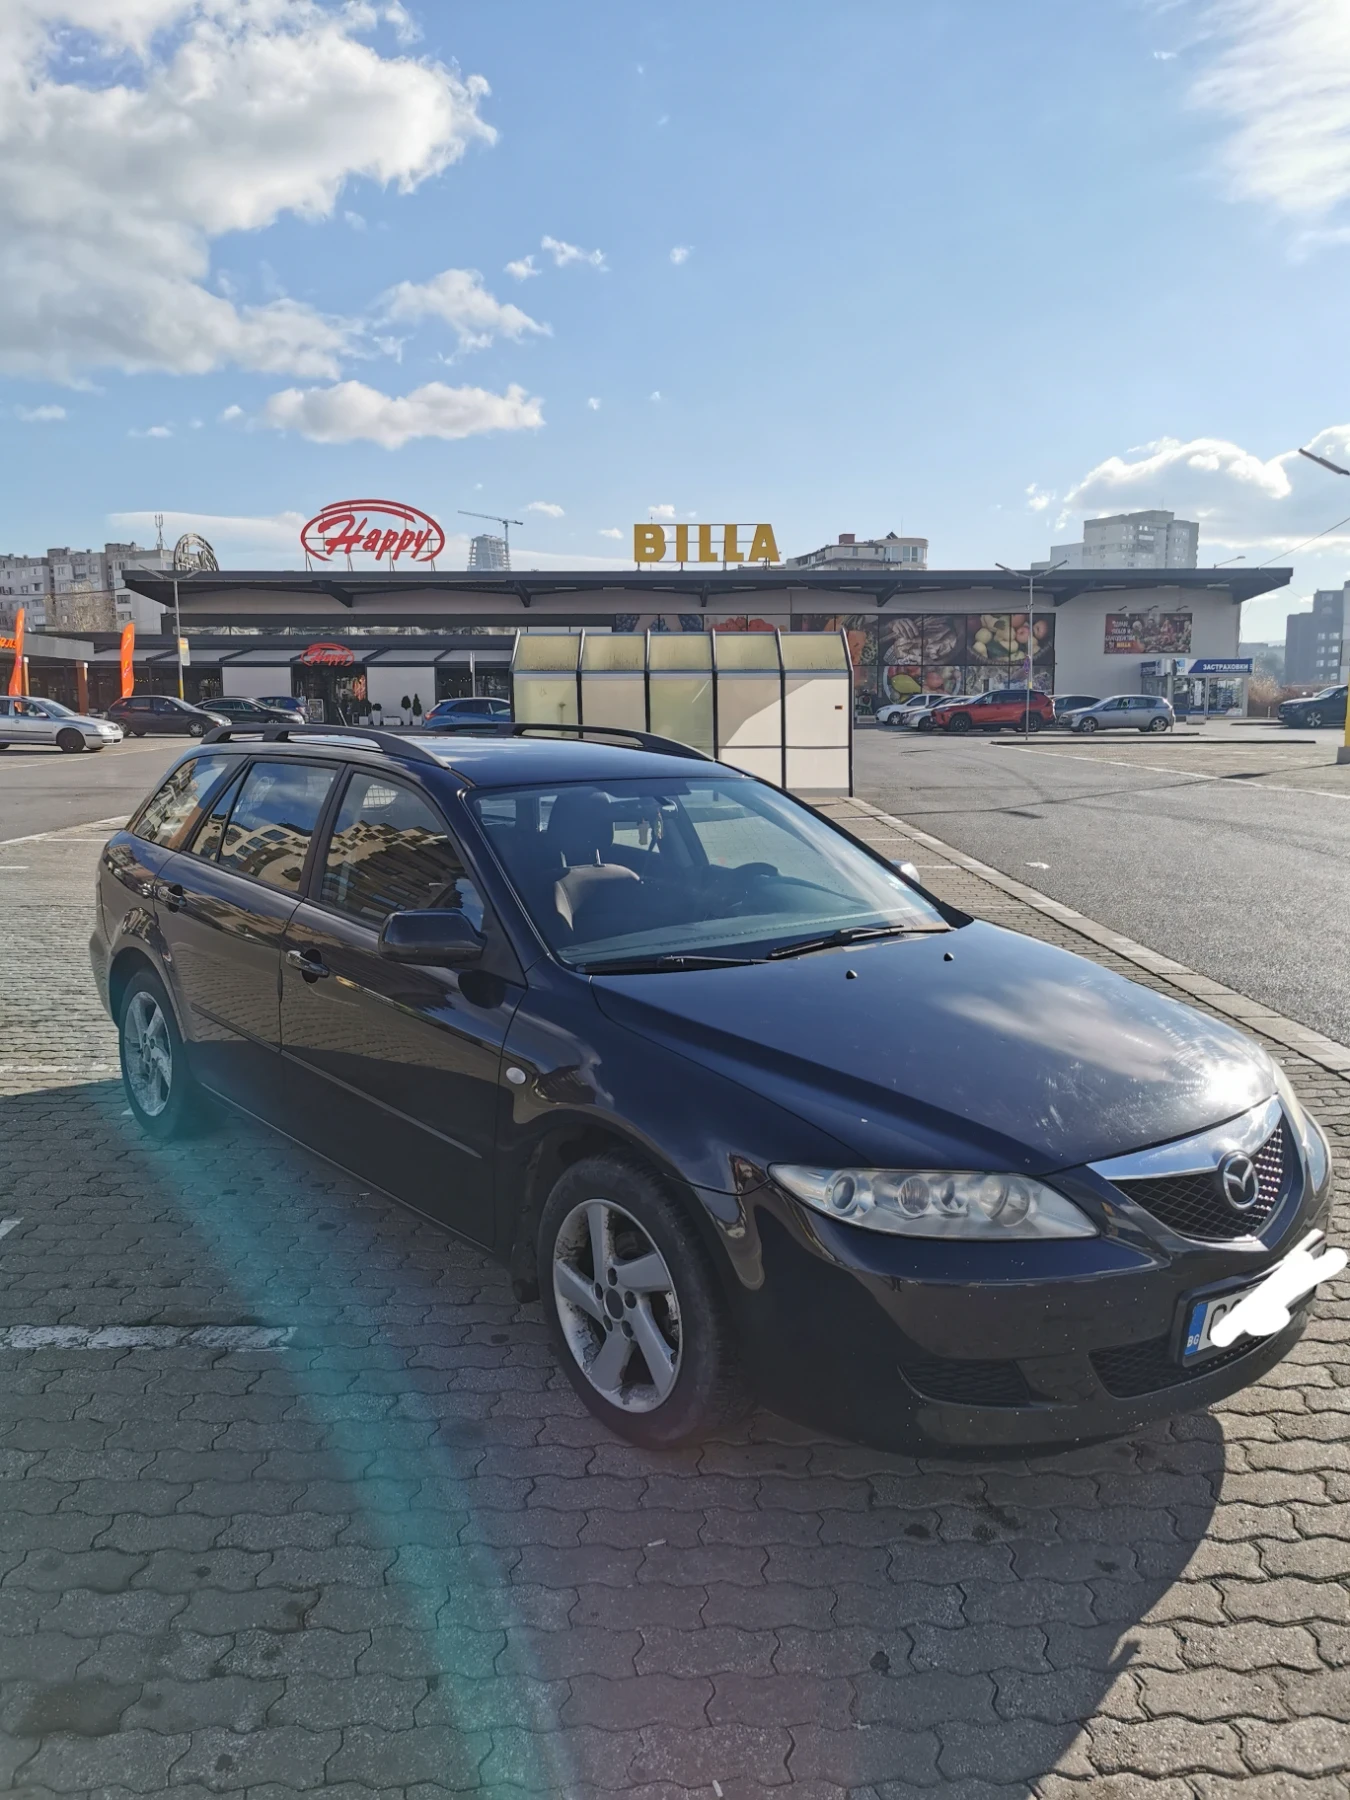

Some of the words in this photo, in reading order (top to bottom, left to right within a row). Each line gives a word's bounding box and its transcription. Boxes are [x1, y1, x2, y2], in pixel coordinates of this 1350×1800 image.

[318, 514, 433, 561] Happy
[633, 523, 781, 563] BILLA
[307, 647, 349, 666] Happy
[1203, 663, 1249, 671] ЗАСТРАХОВКИ
[1187, 1333, 1200, 1348] BG
